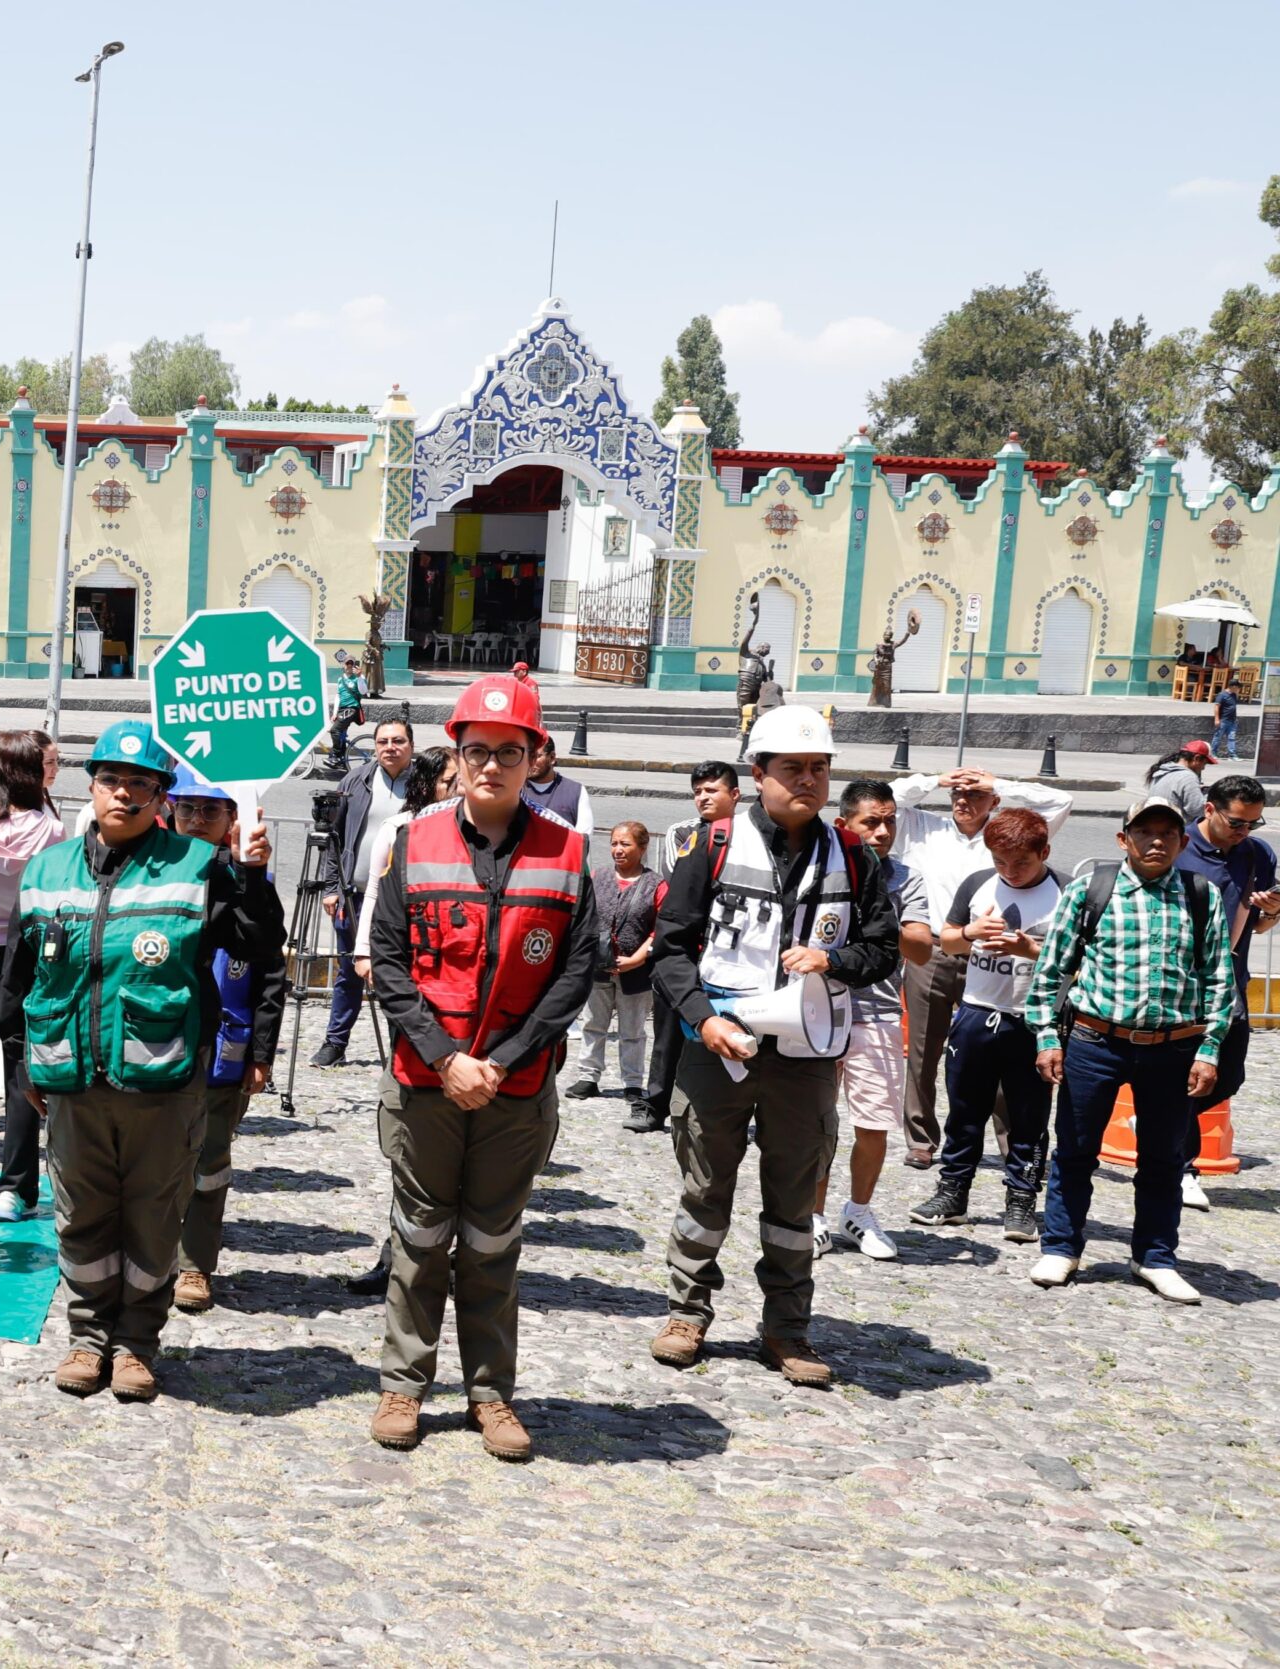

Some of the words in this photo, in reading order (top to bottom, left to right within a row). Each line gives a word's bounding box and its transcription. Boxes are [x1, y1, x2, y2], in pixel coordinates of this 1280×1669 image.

[967, 615, 978, 623] NO
[595, 651, 625, 672] 1930
[175, 672, 263, 697] PUNTO
[268, 670, 302, 692] DE
[163, 695, 317, 725] ENCUENTRO
[970, 953, 1034, 976] adida
